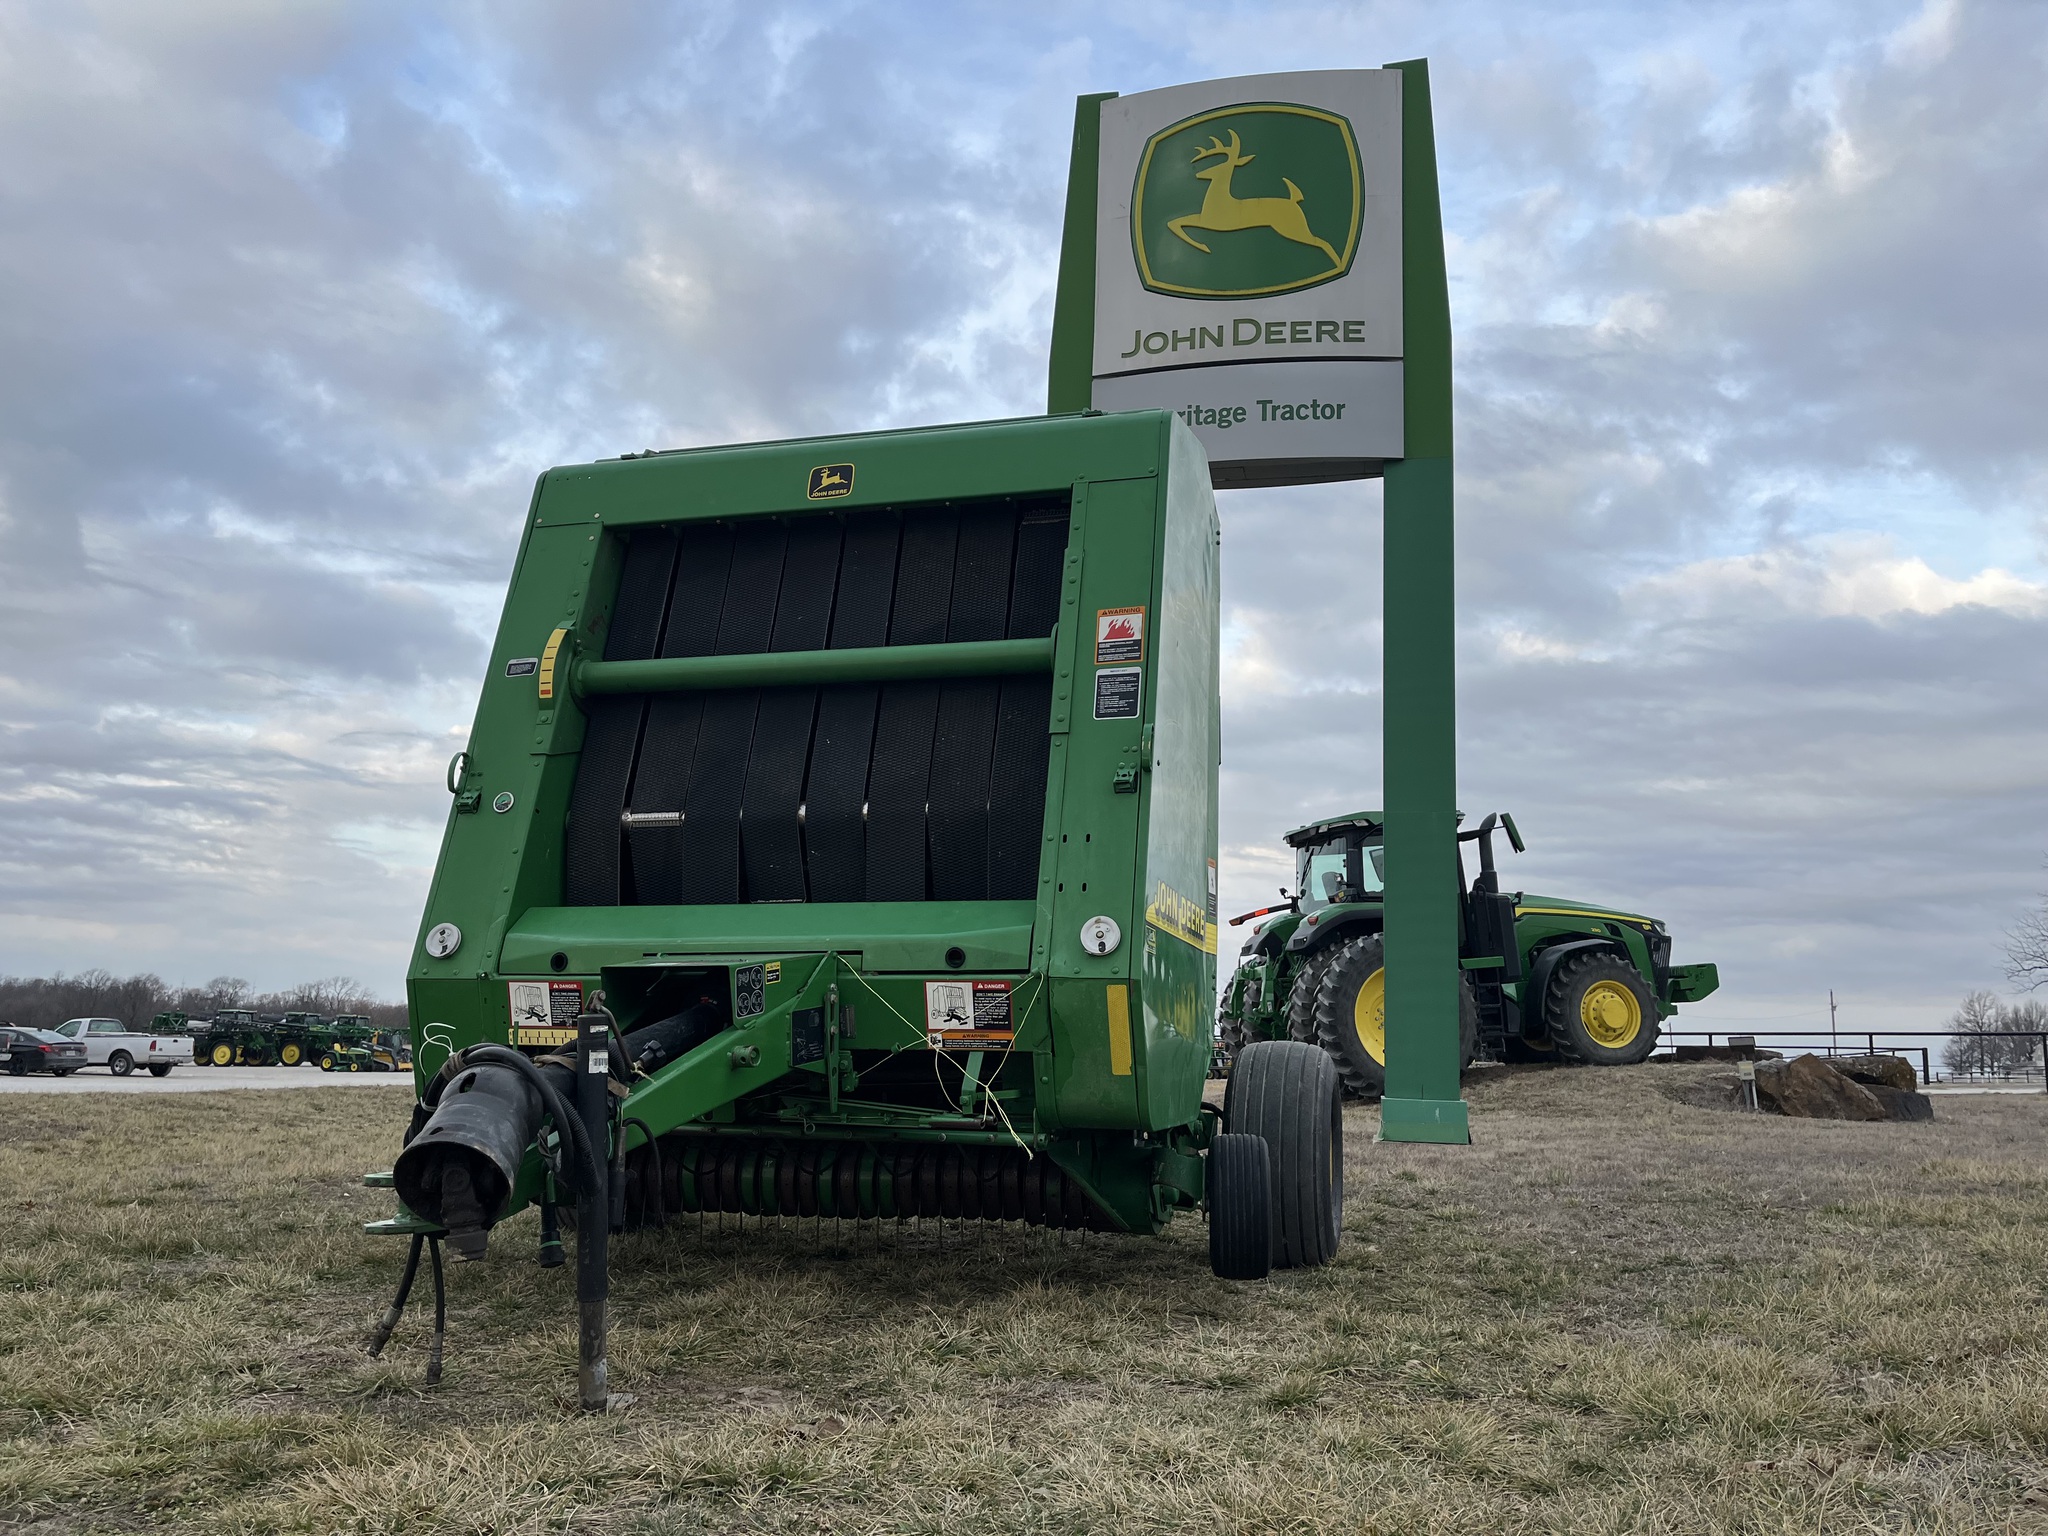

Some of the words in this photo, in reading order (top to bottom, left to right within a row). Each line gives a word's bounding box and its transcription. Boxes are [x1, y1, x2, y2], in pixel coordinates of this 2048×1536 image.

[1121, 325, 1224, 358] JOHN
[1232, 318, 1365, 346] DEERE
[1177, 404, 1247, 428] ritage
[1256, 399, 1346, 421] Tractor
[1107, 607, 1141, 615] WARNING
[1154, 879, 1178, 921] JOHN
[1181, 896, 1205, 936] DEERE
